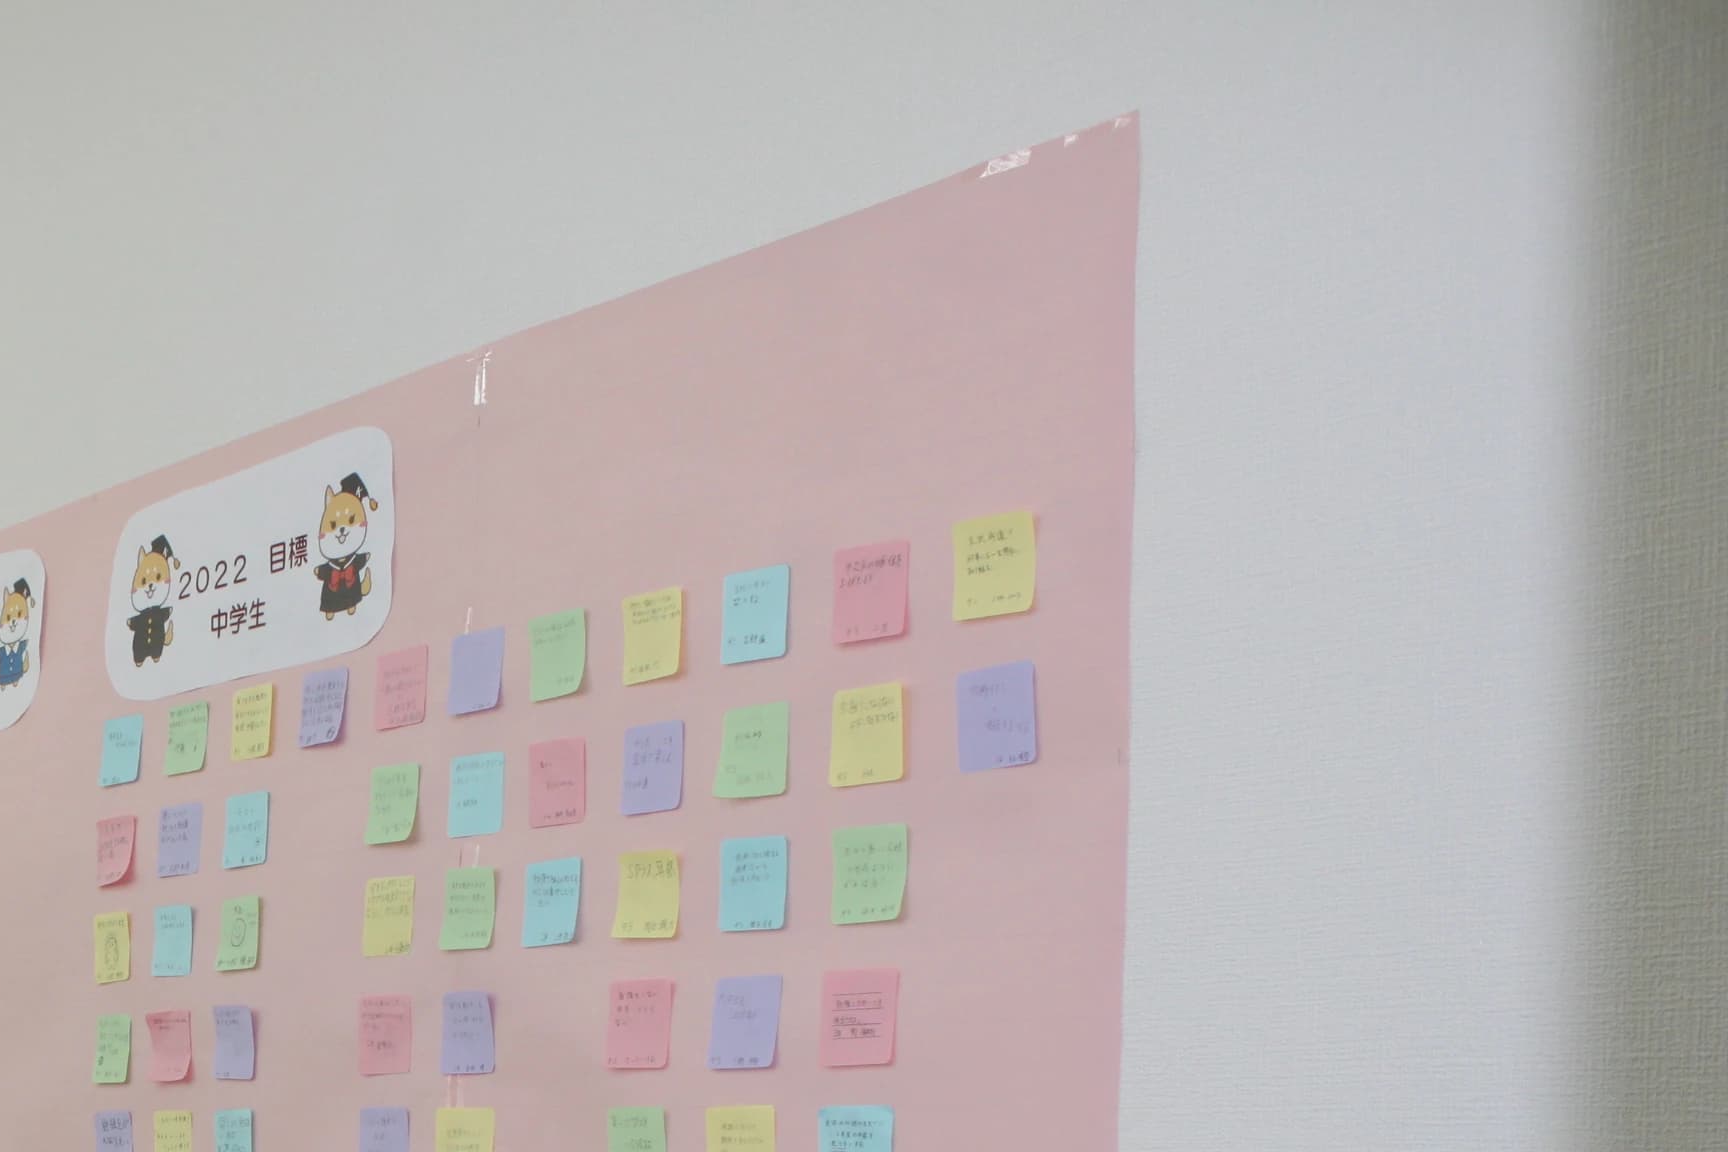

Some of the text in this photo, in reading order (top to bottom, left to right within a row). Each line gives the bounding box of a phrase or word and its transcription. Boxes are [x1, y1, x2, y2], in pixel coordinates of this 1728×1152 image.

[178, 534, 309, 600] 2022 目標
[210, 597, 267, 639] 中学生
